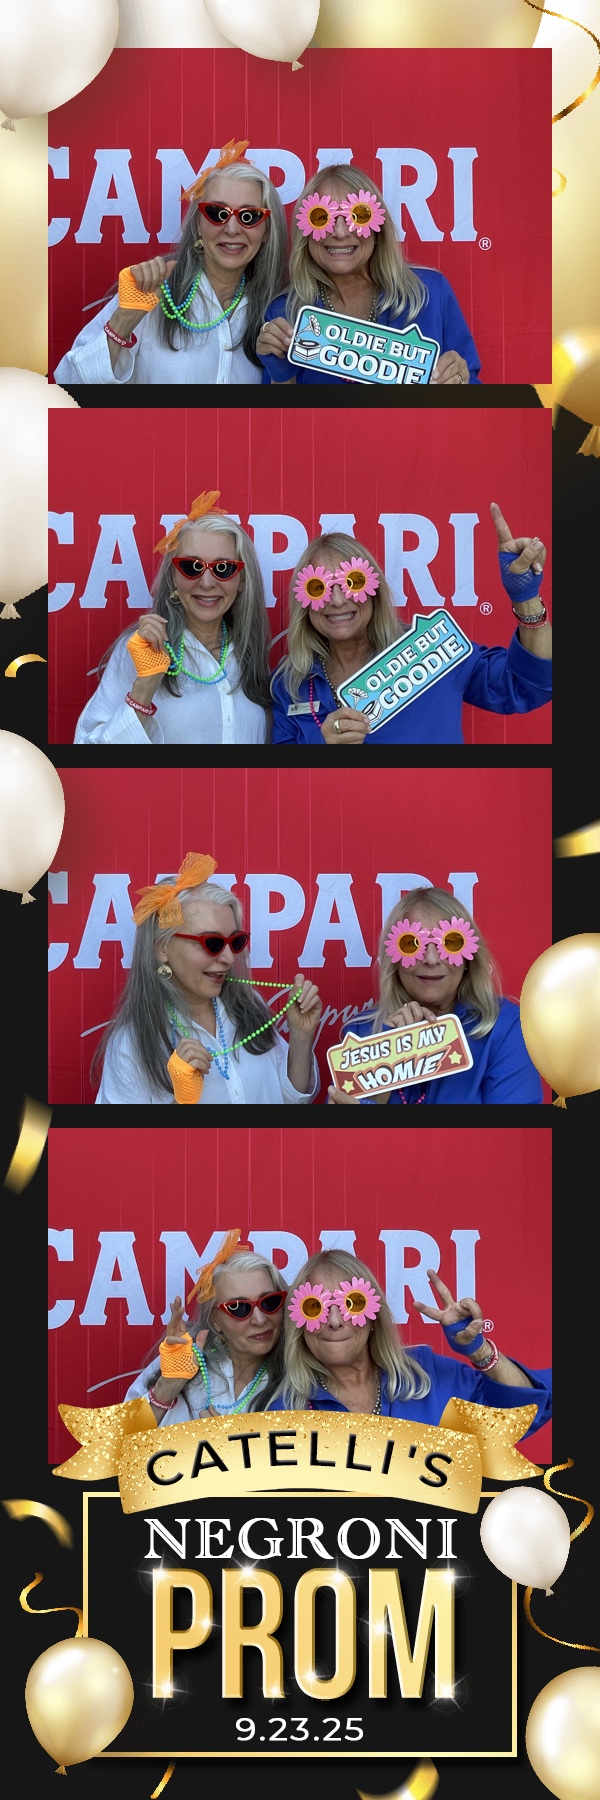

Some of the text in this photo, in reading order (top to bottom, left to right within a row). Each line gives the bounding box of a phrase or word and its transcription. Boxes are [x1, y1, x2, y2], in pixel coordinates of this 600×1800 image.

[319, 344, 426, 384] GOODIE
[325, 324, 432, 364] OLDIE BUT
[366, 618, 449, 691] OLDIE BUT
[379, 633, 464, 710] GOODIE
[340, 1024, 446, 1070] JESUS IS MY
[357, 1049, 446, 1091] HOMIE
